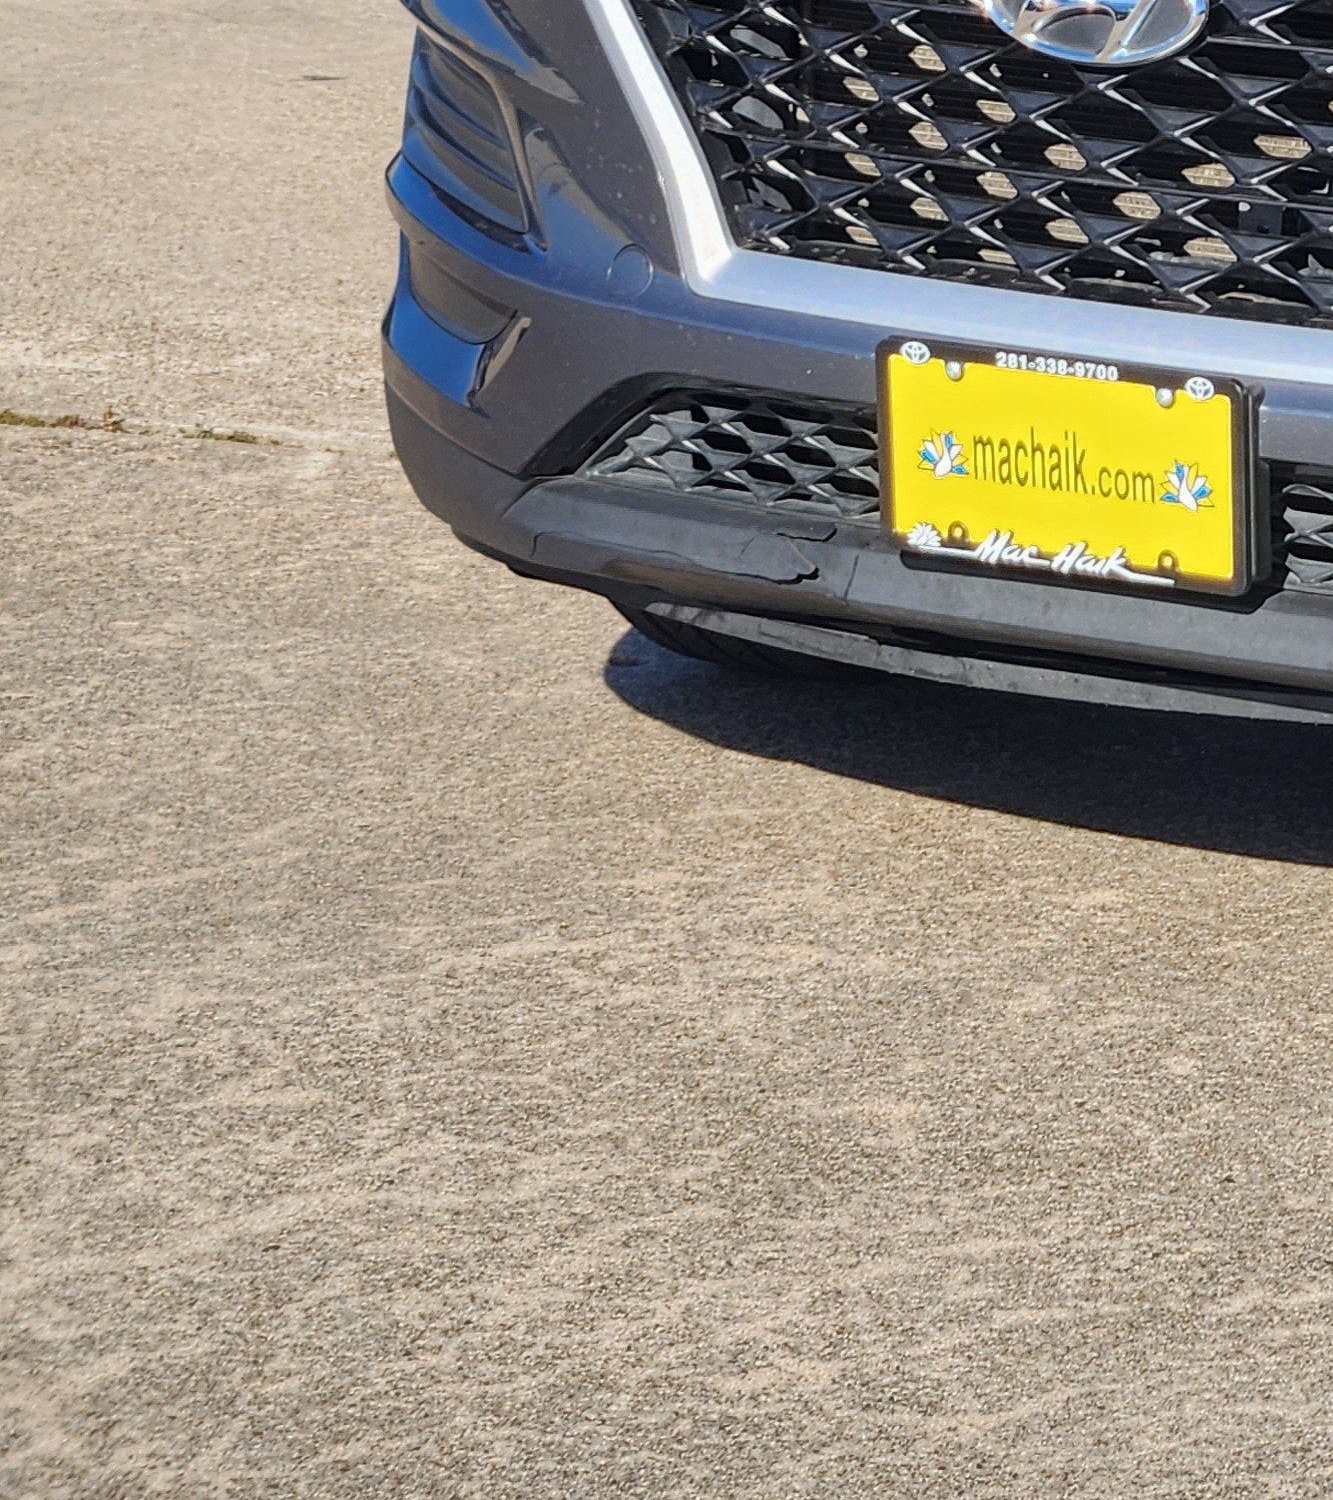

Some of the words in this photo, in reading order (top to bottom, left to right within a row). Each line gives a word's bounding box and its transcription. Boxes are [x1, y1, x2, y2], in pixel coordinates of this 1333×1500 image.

[995, 350, 1119, 381] 281-338-9700
[973, 425, 1156, 504] machaik.com
[976, 528, 1050, 566] Mac
